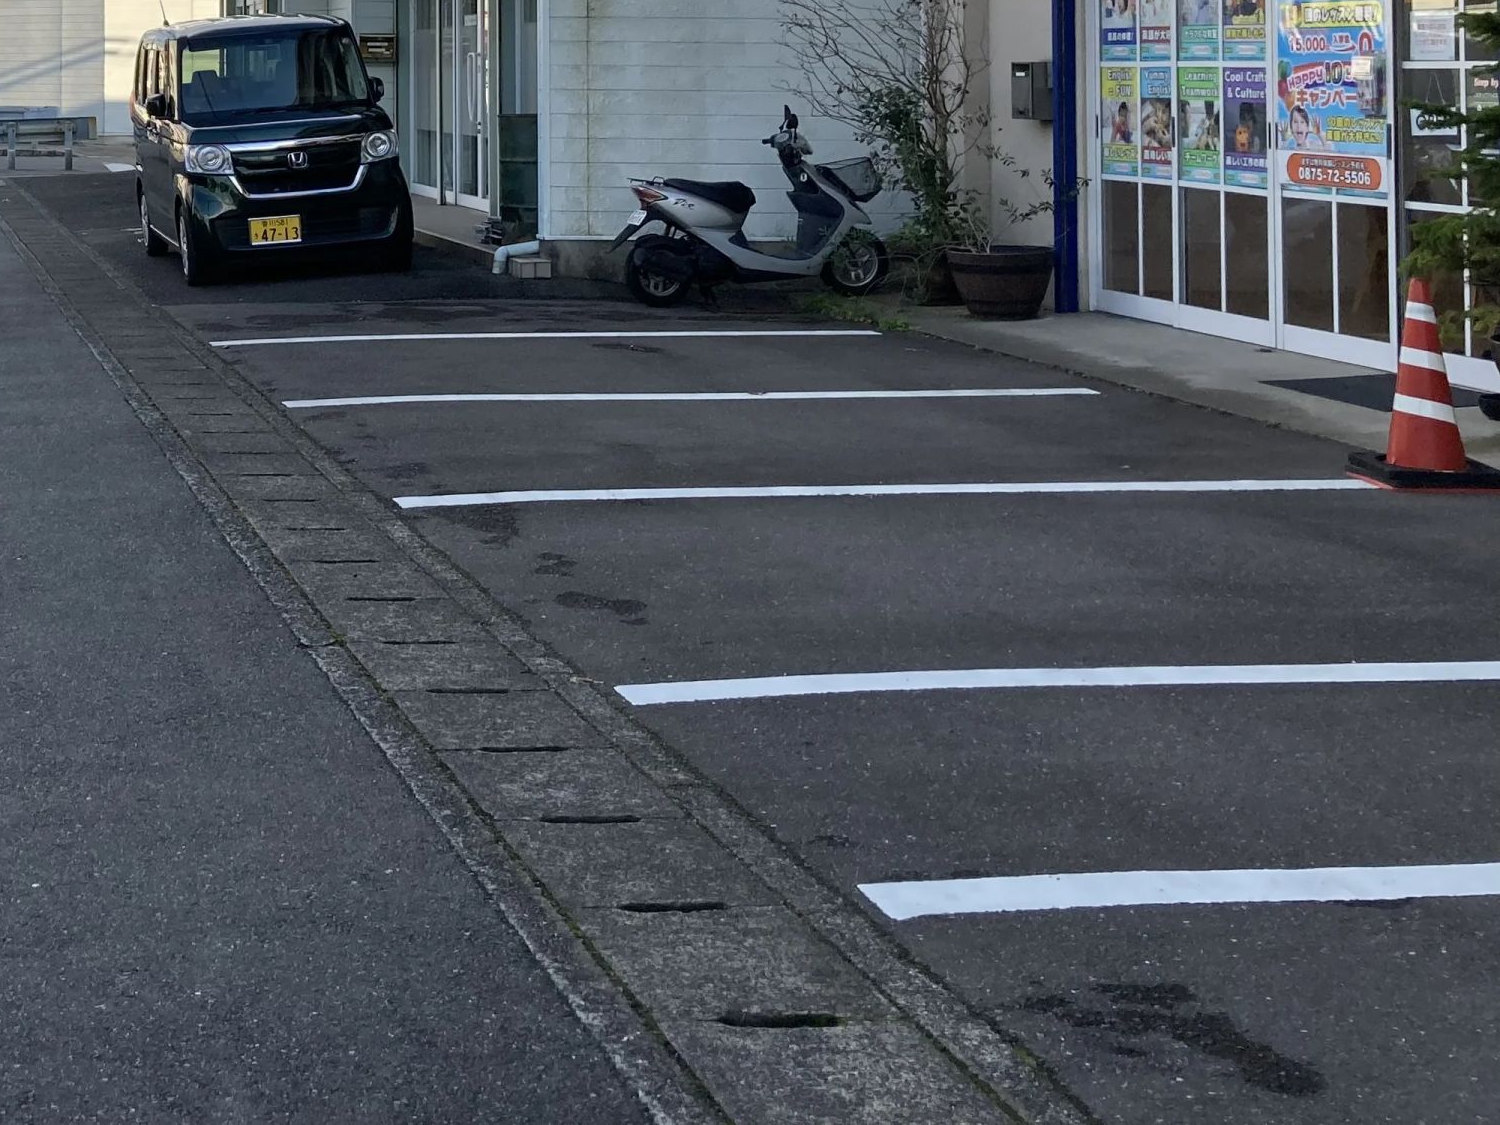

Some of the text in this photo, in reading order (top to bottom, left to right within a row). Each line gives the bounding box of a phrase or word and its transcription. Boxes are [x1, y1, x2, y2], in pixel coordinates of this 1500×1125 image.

[1184, 71, 1217, 84] Learning
[1224, 70, 1244, 82] Cool
[1288, 68, 1323, 88] Happy
[1297, 89, 1358, 108] キャンペー
[1298, 167, 1371, 185] 0875-72-5506
[262, 227, 299, 242] 47-13
